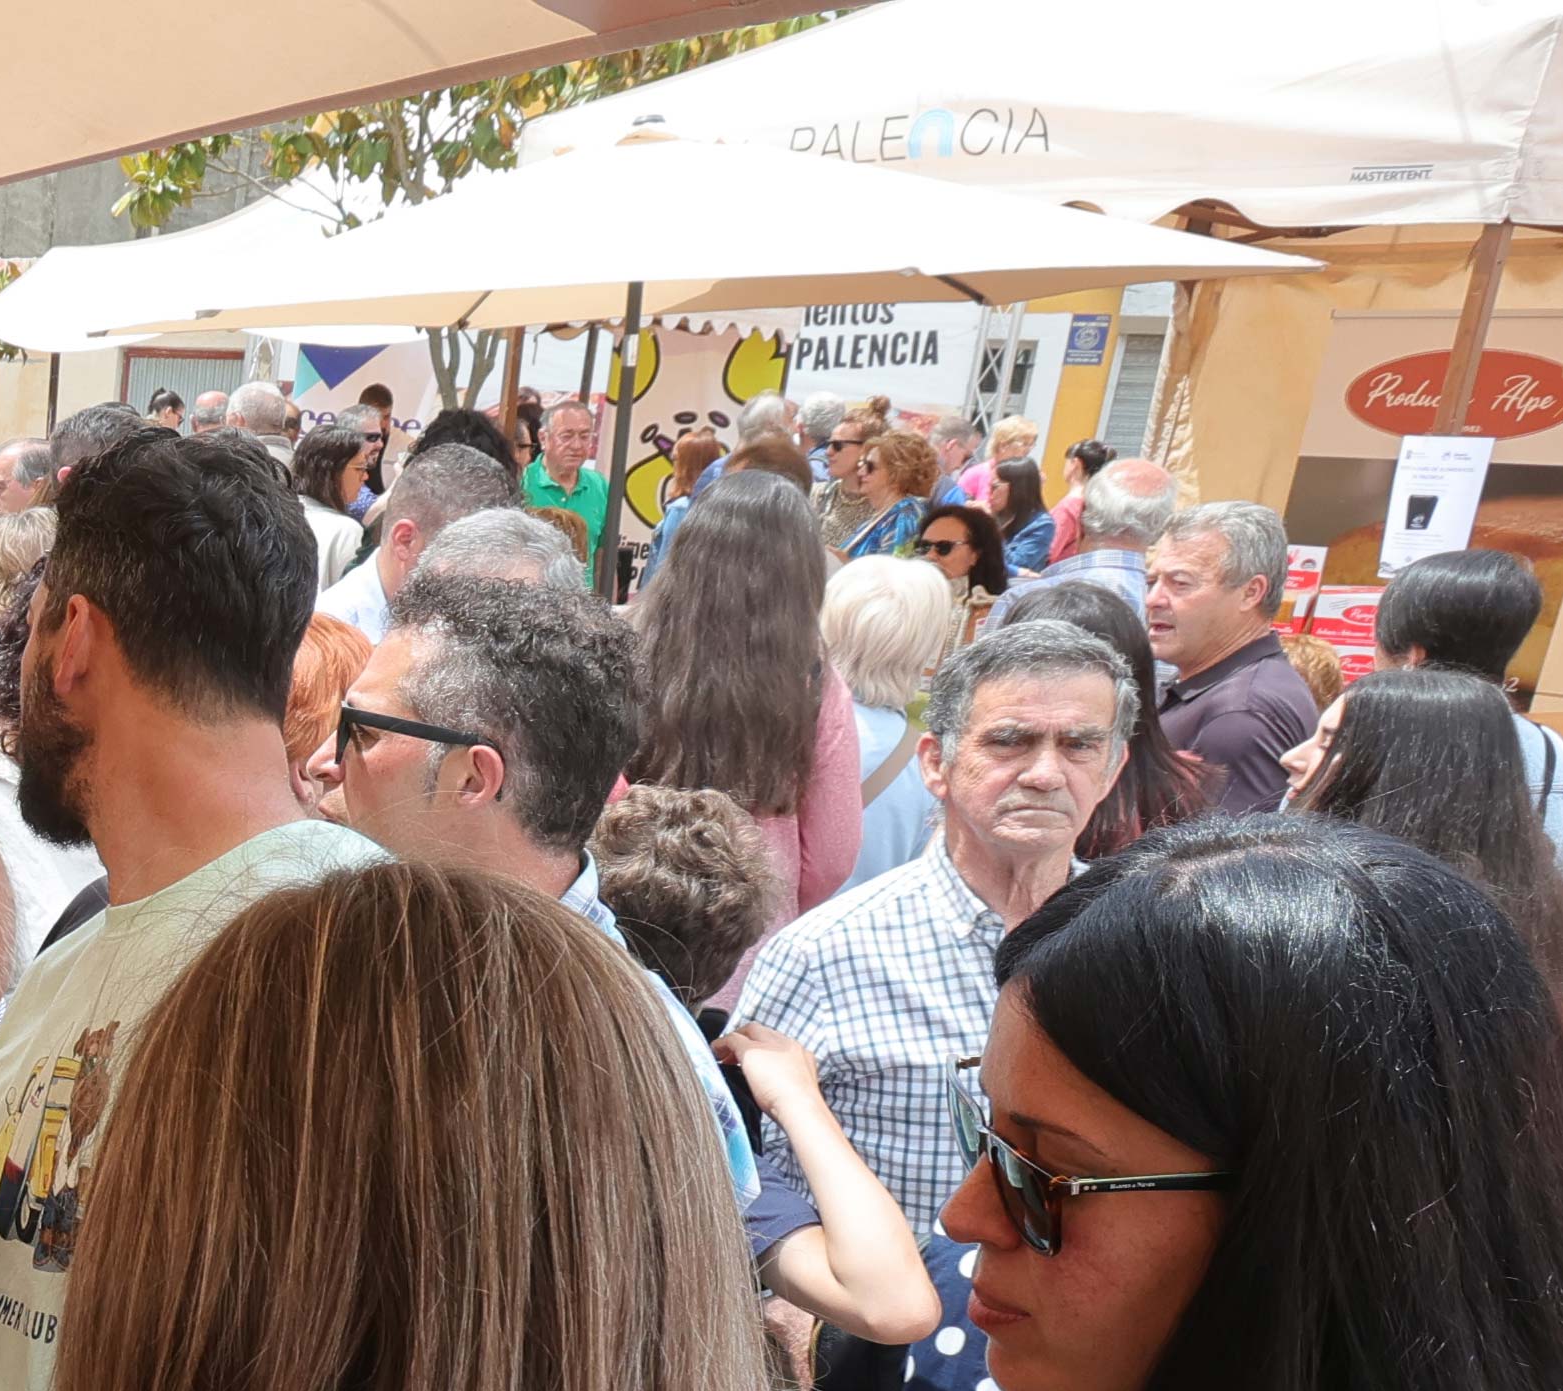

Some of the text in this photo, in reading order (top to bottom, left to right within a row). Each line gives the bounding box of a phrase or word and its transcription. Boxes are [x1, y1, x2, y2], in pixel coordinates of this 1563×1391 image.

[1350, 169, 1433, 184] MASTERTENT
[795, 330, 940, 372] PALENCIA
[1365, 372, 1556, 421] Produc Alpe
